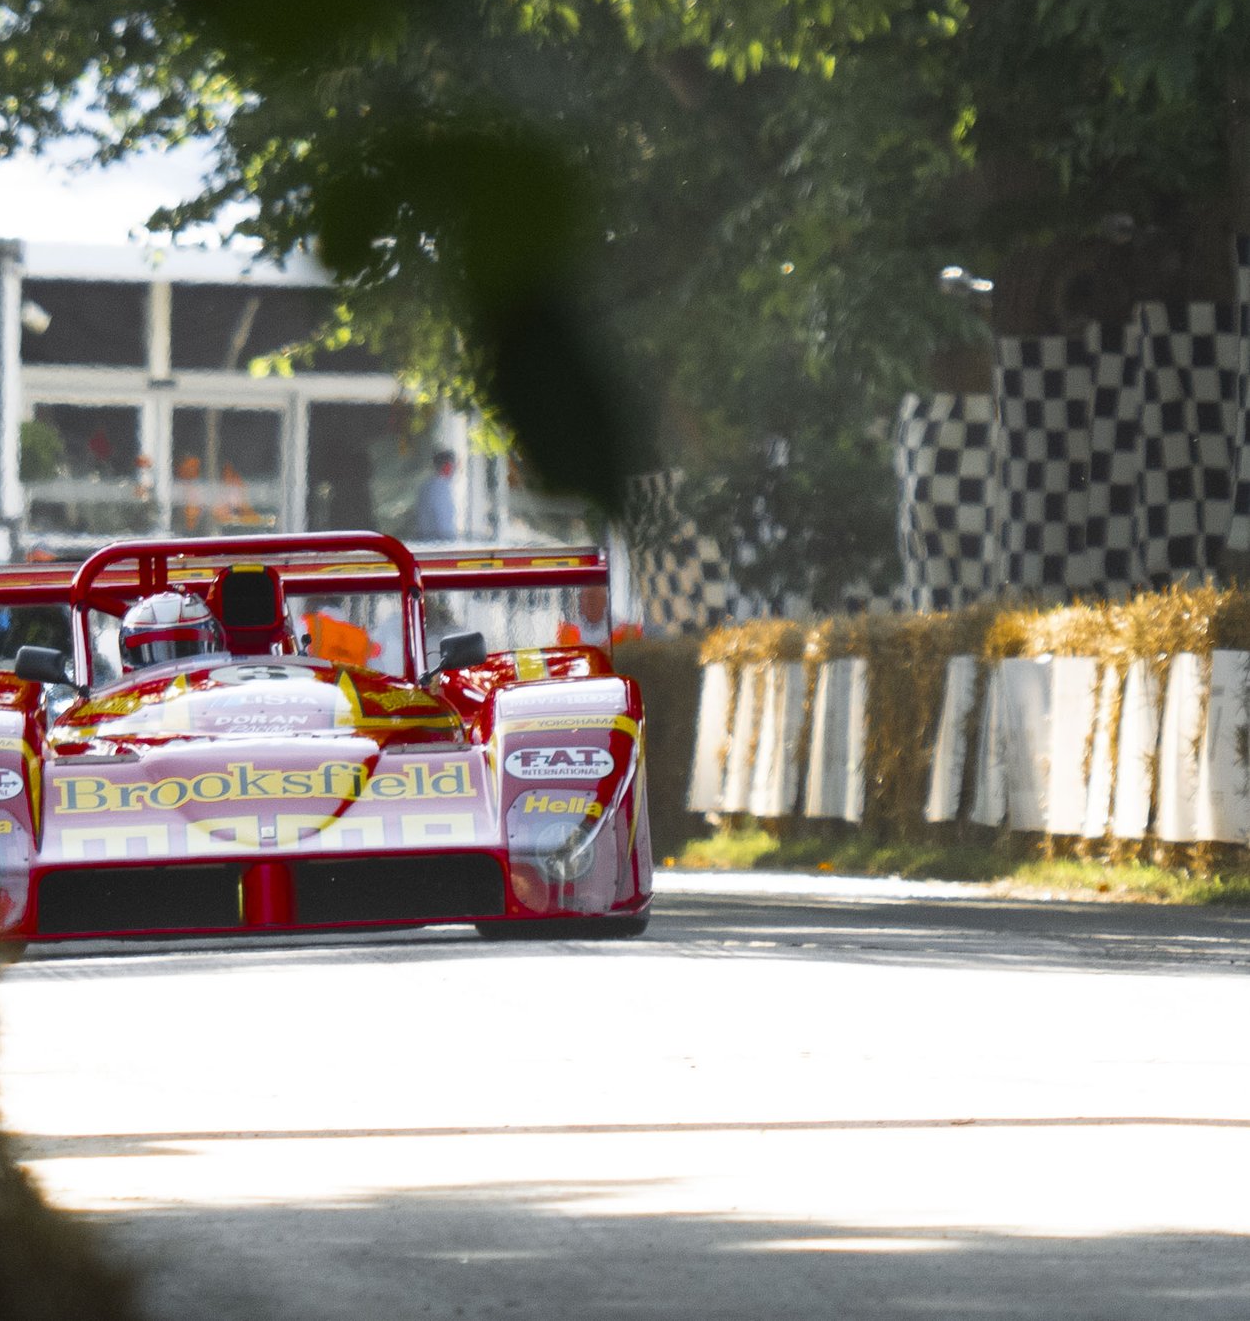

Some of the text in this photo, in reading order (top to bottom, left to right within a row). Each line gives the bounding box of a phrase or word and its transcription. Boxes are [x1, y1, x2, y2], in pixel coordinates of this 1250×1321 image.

[214, 714, 309, 726] DORAN
[536, 717, 619, 728] YOKOHAMA
[521, 767, 600, 776] INTERNATIONAL
[55, 761, 477, 813] Brooksfield
[523, 795, 603, 819] Hella
